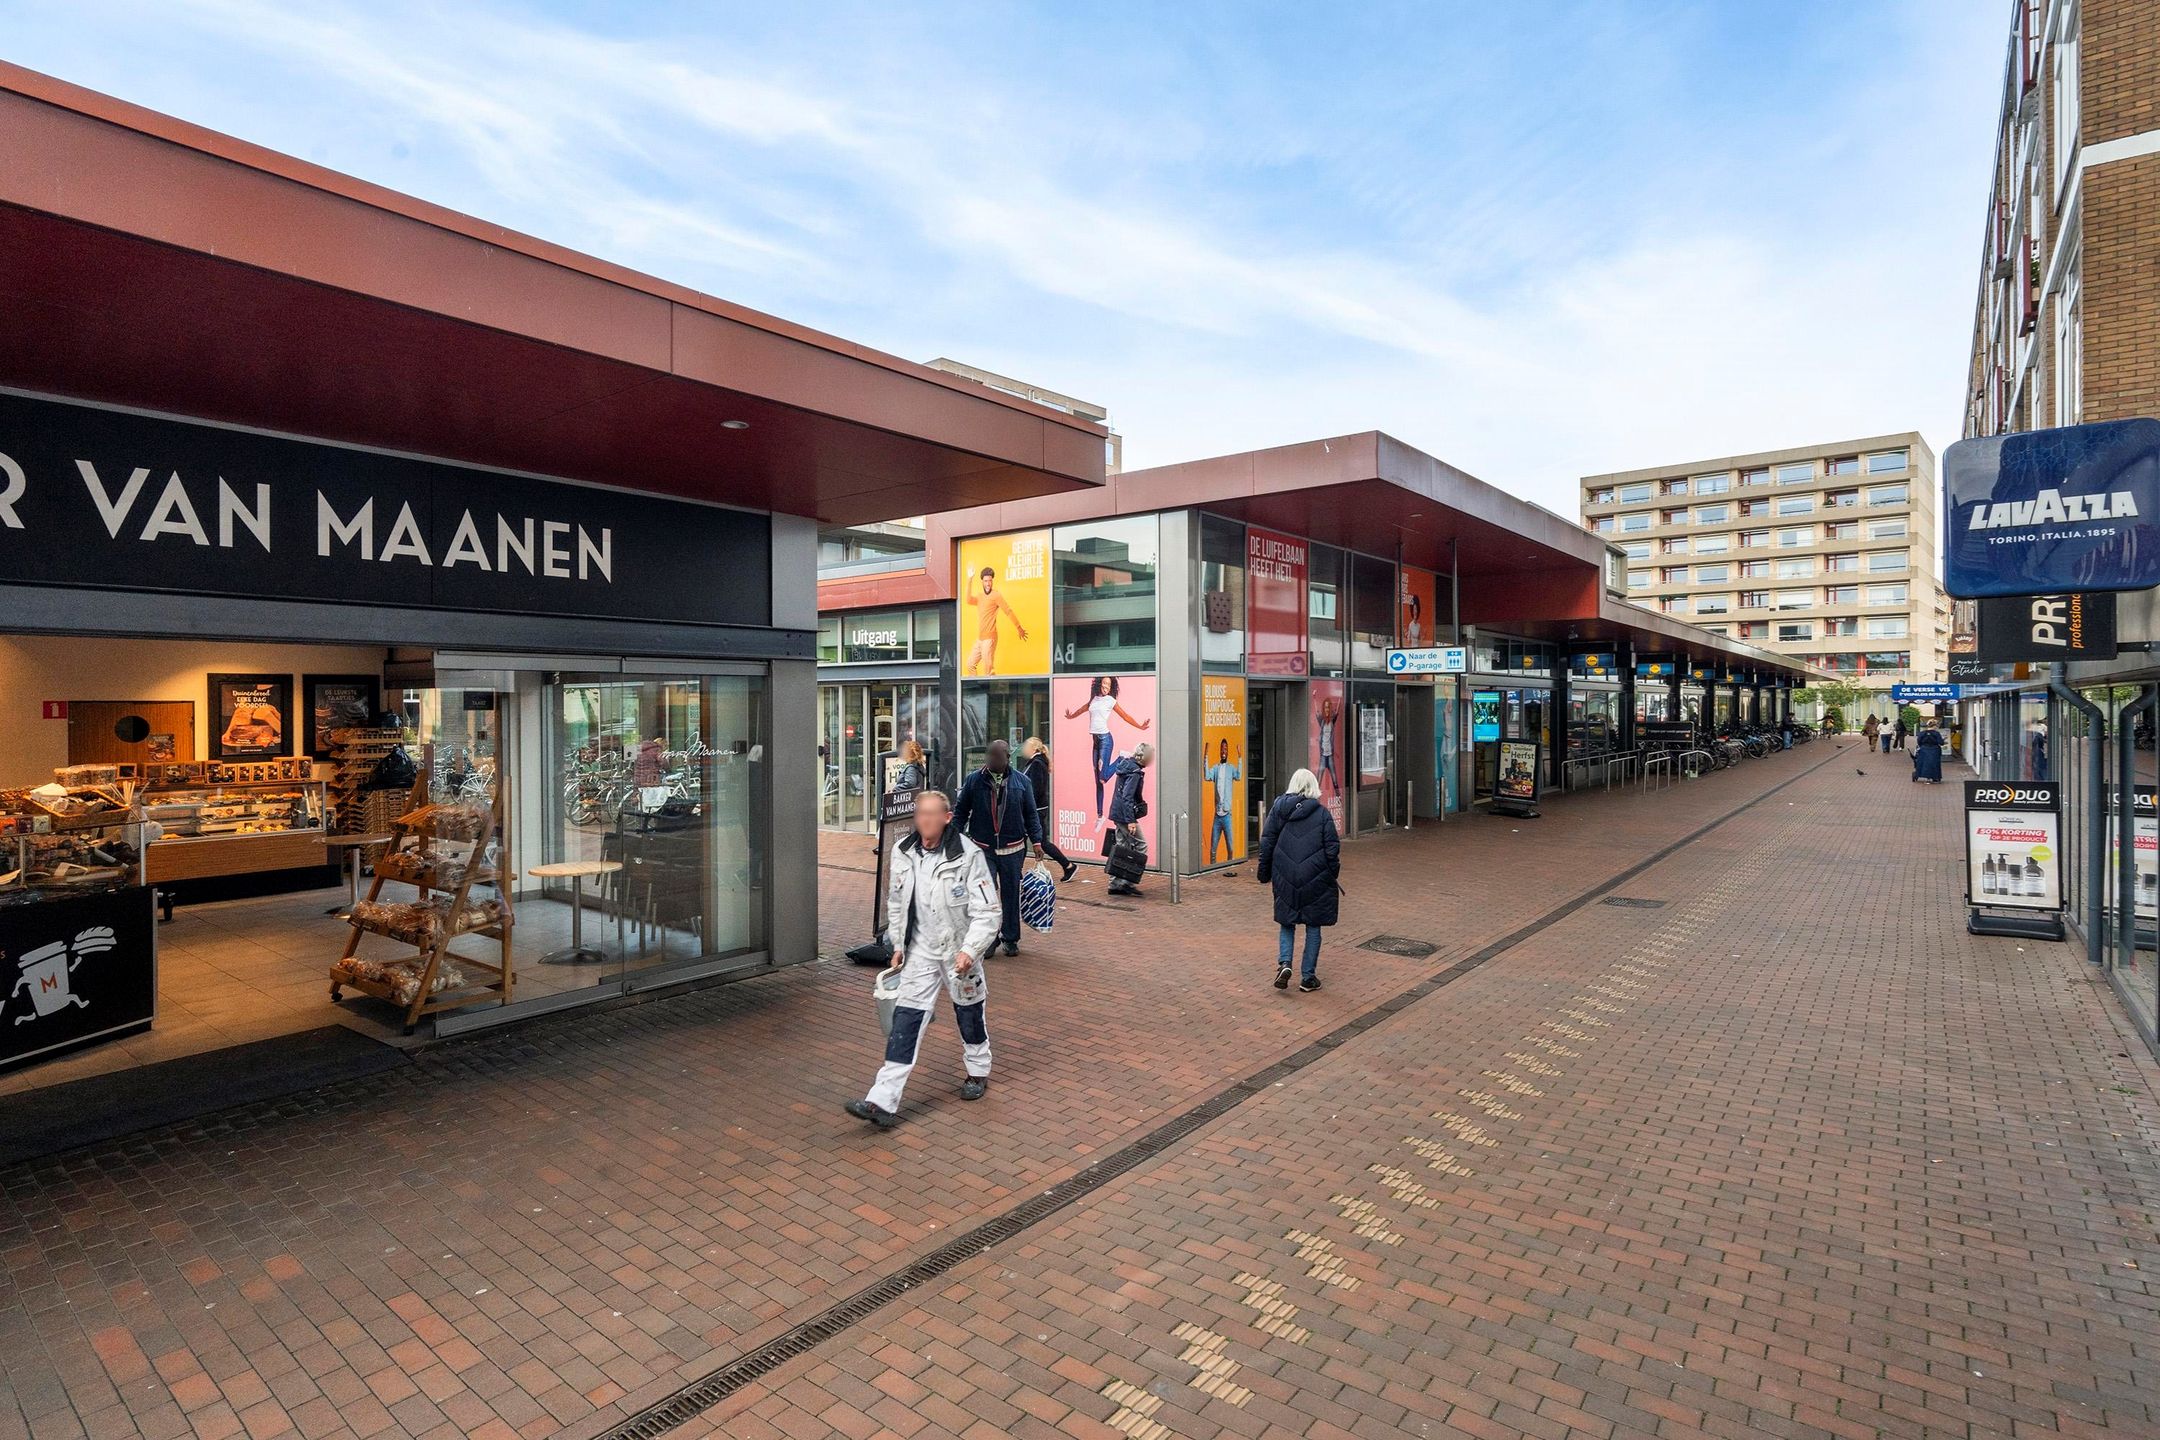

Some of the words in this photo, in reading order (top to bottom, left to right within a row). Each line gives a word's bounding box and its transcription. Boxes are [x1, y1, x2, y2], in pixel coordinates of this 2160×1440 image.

[1968, 488, 2139, 530] LAVAZZA
[74, 459, 271, 553] VAN
[317, 488, 612, 584] MAANEN
[2087, 528, 2116, 537] 1895
[1250, 535, 1261, 556] DE
[1262, 538, 1305, 566] LUIFELBAAN
[1250, 556, 1274, 580] HEEFT
[1275, 561, 1292, 582] HET!
[2032, 595, 2067, 647] PR
[852, 629, 898, 648] Uitgang
[1408, 662, 1443, 671] P-garage
[1950, 664, 1986, 676] Studio
[1205, 698, 1235, 712] TOMPOUCE
[1511, 751, 1535, 760] Herfst
[893, 792, 912, 805] BAKKER
[885, 803, 897, 816] VAN
[1059, 810, 1086, 825] BROOD
[1059, 823, 1080, 838] NOOT
[1060, 837, 1095, 852] POTLOOD
[41, 971, 58, 993] M
